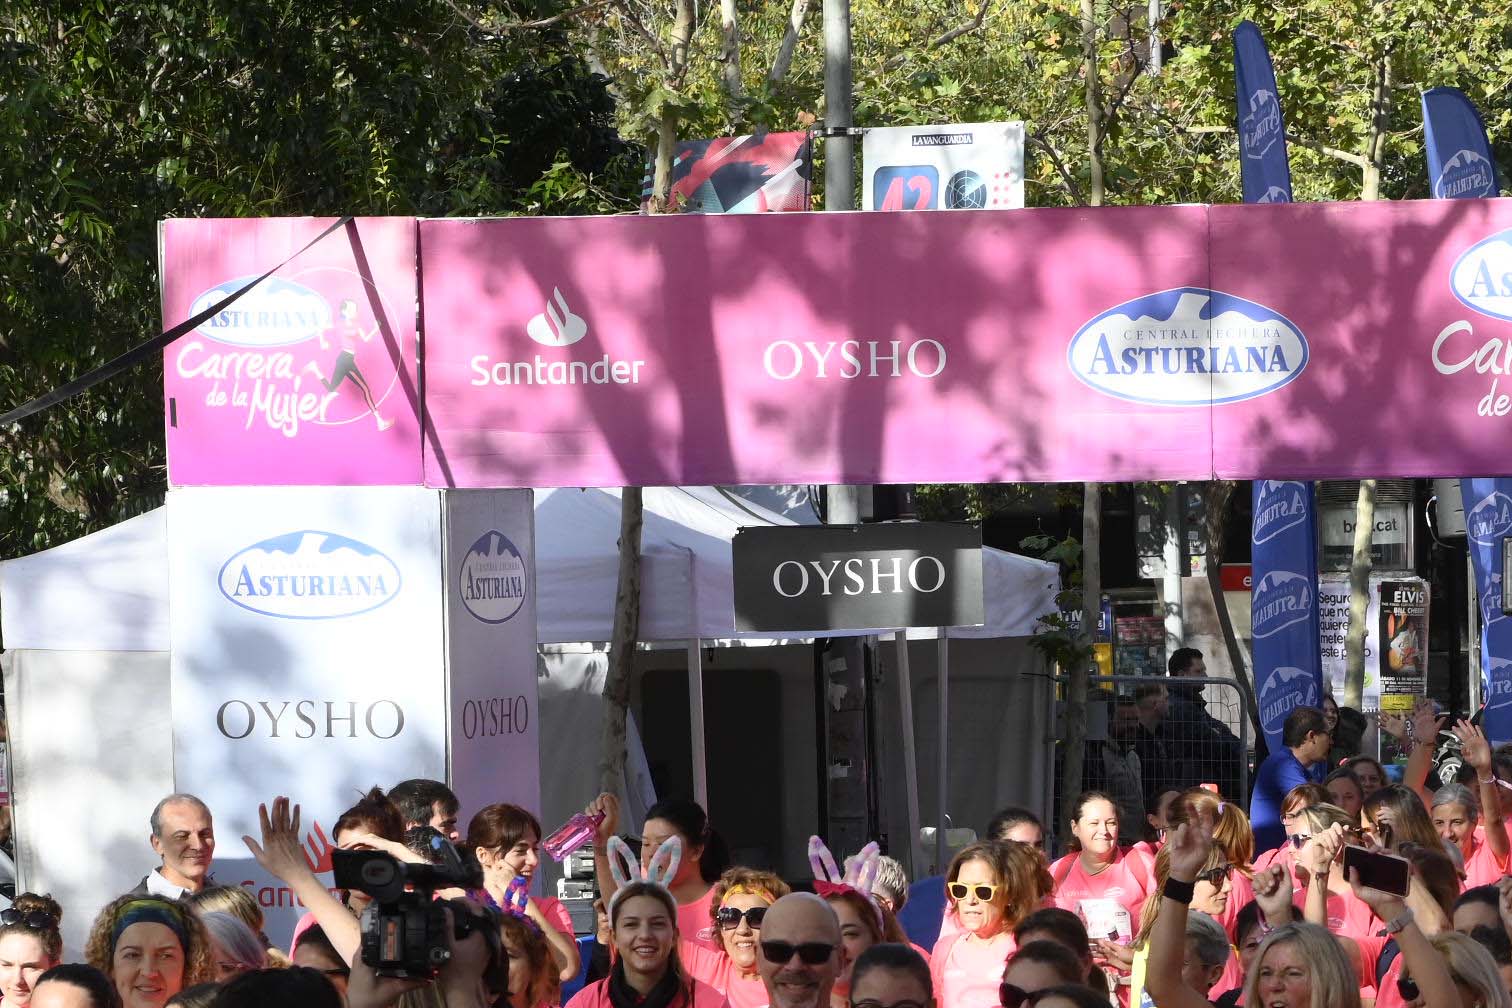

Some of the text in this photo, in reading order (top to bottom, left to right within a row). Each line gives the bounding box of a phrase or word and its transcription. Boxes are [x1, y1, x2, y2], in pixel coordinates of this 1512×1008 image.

[1088, 333, 1290, 375] ASTURIANA
[1123, 329, 1198, 341] CENTRAL
[176, 341, 295, 379] Carrera
[471, 354, 645, 386] Santander
[763, 339, 947, 380] OYSHO
[206, 375, 340, 437] de la Mujer
[1478, 378, 1512, 417] de
[233, 565, 388, 598] ASTURIANA
[465, 566, 523, 601] ASTURIANA
[773, 556, 946, 597] OYSHO
[1394, 591, 1424, 603] ELVIS
[216, 700, 405, 740] OYSHO
[463, 695, 529, 739] OYSHO
